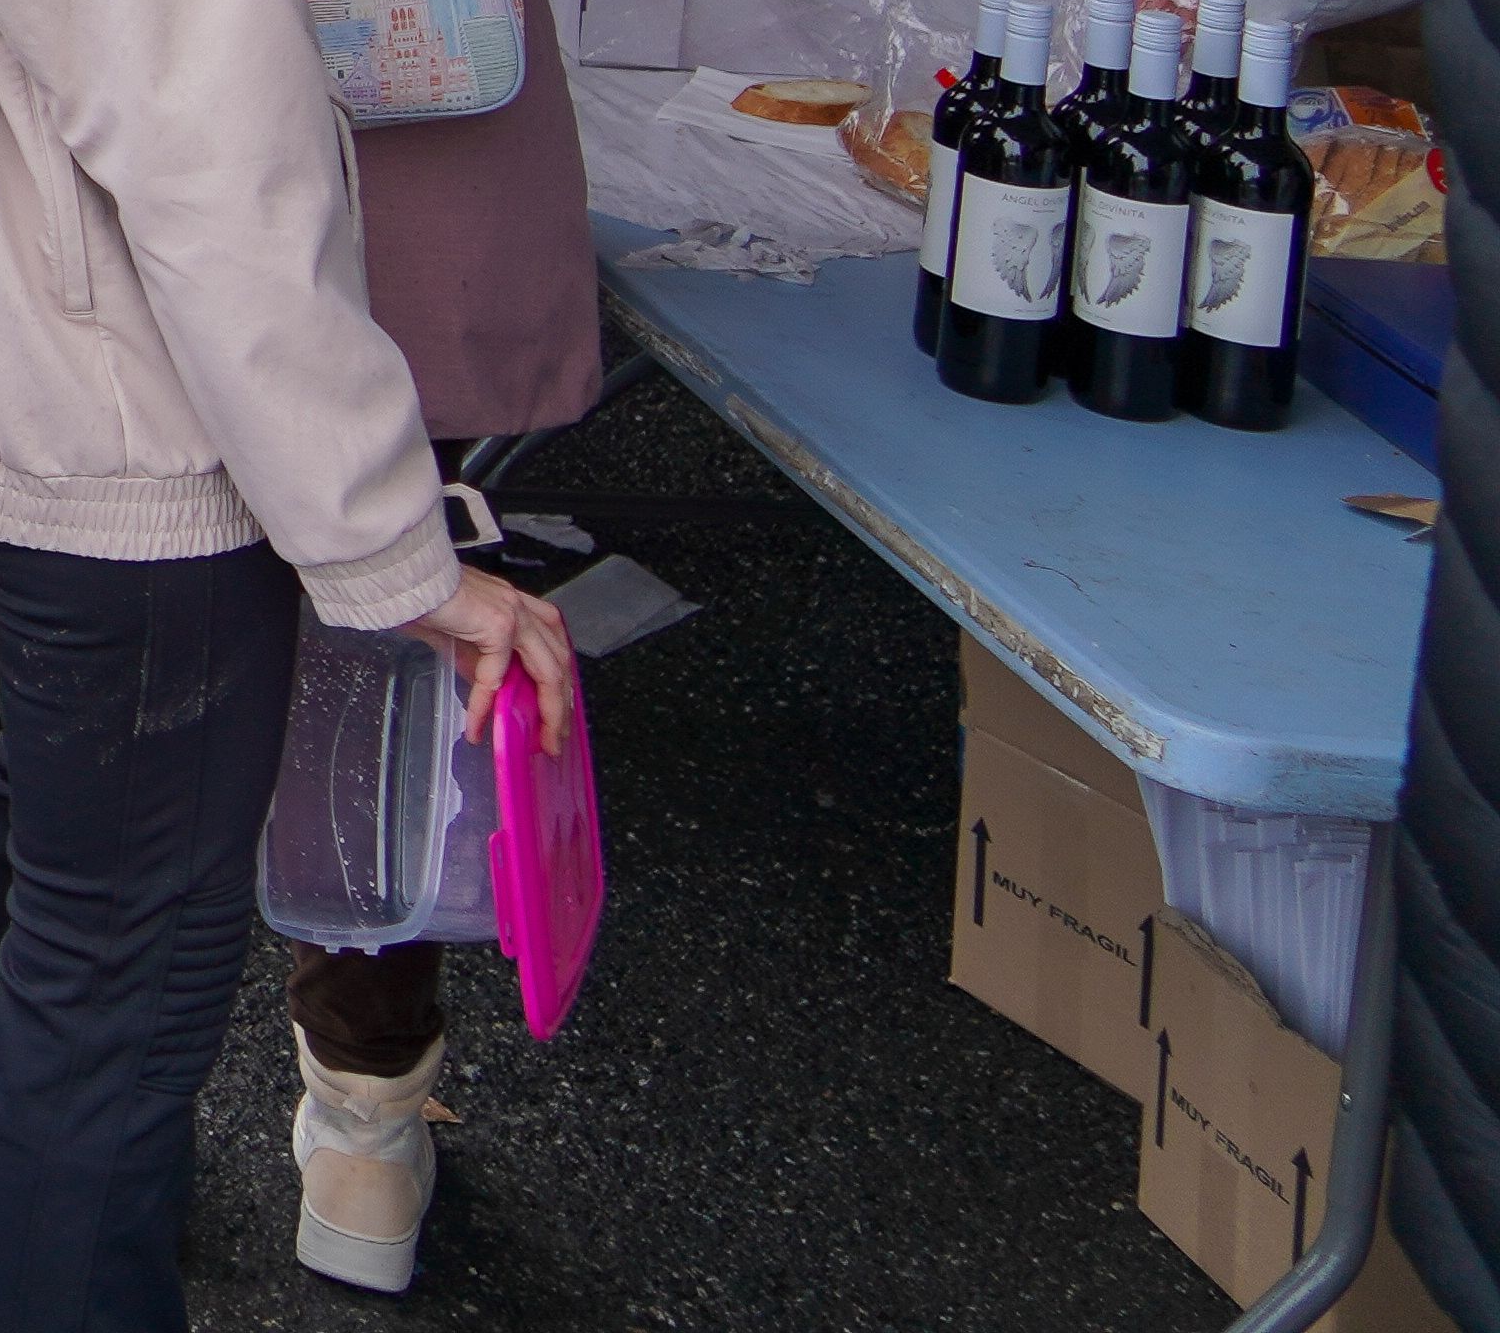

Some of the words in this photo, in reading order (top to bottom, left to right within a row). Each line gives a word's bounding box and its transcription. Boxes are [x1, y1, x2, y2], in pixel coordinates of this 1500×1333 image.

[993, 870, 1042, 907] MUY
[1049, 903, 1138, 967] FRAGIL
[1172, 1087, 1211, 1131] MUY
[1216, 1129, 1290, 1204] FRAGIL
